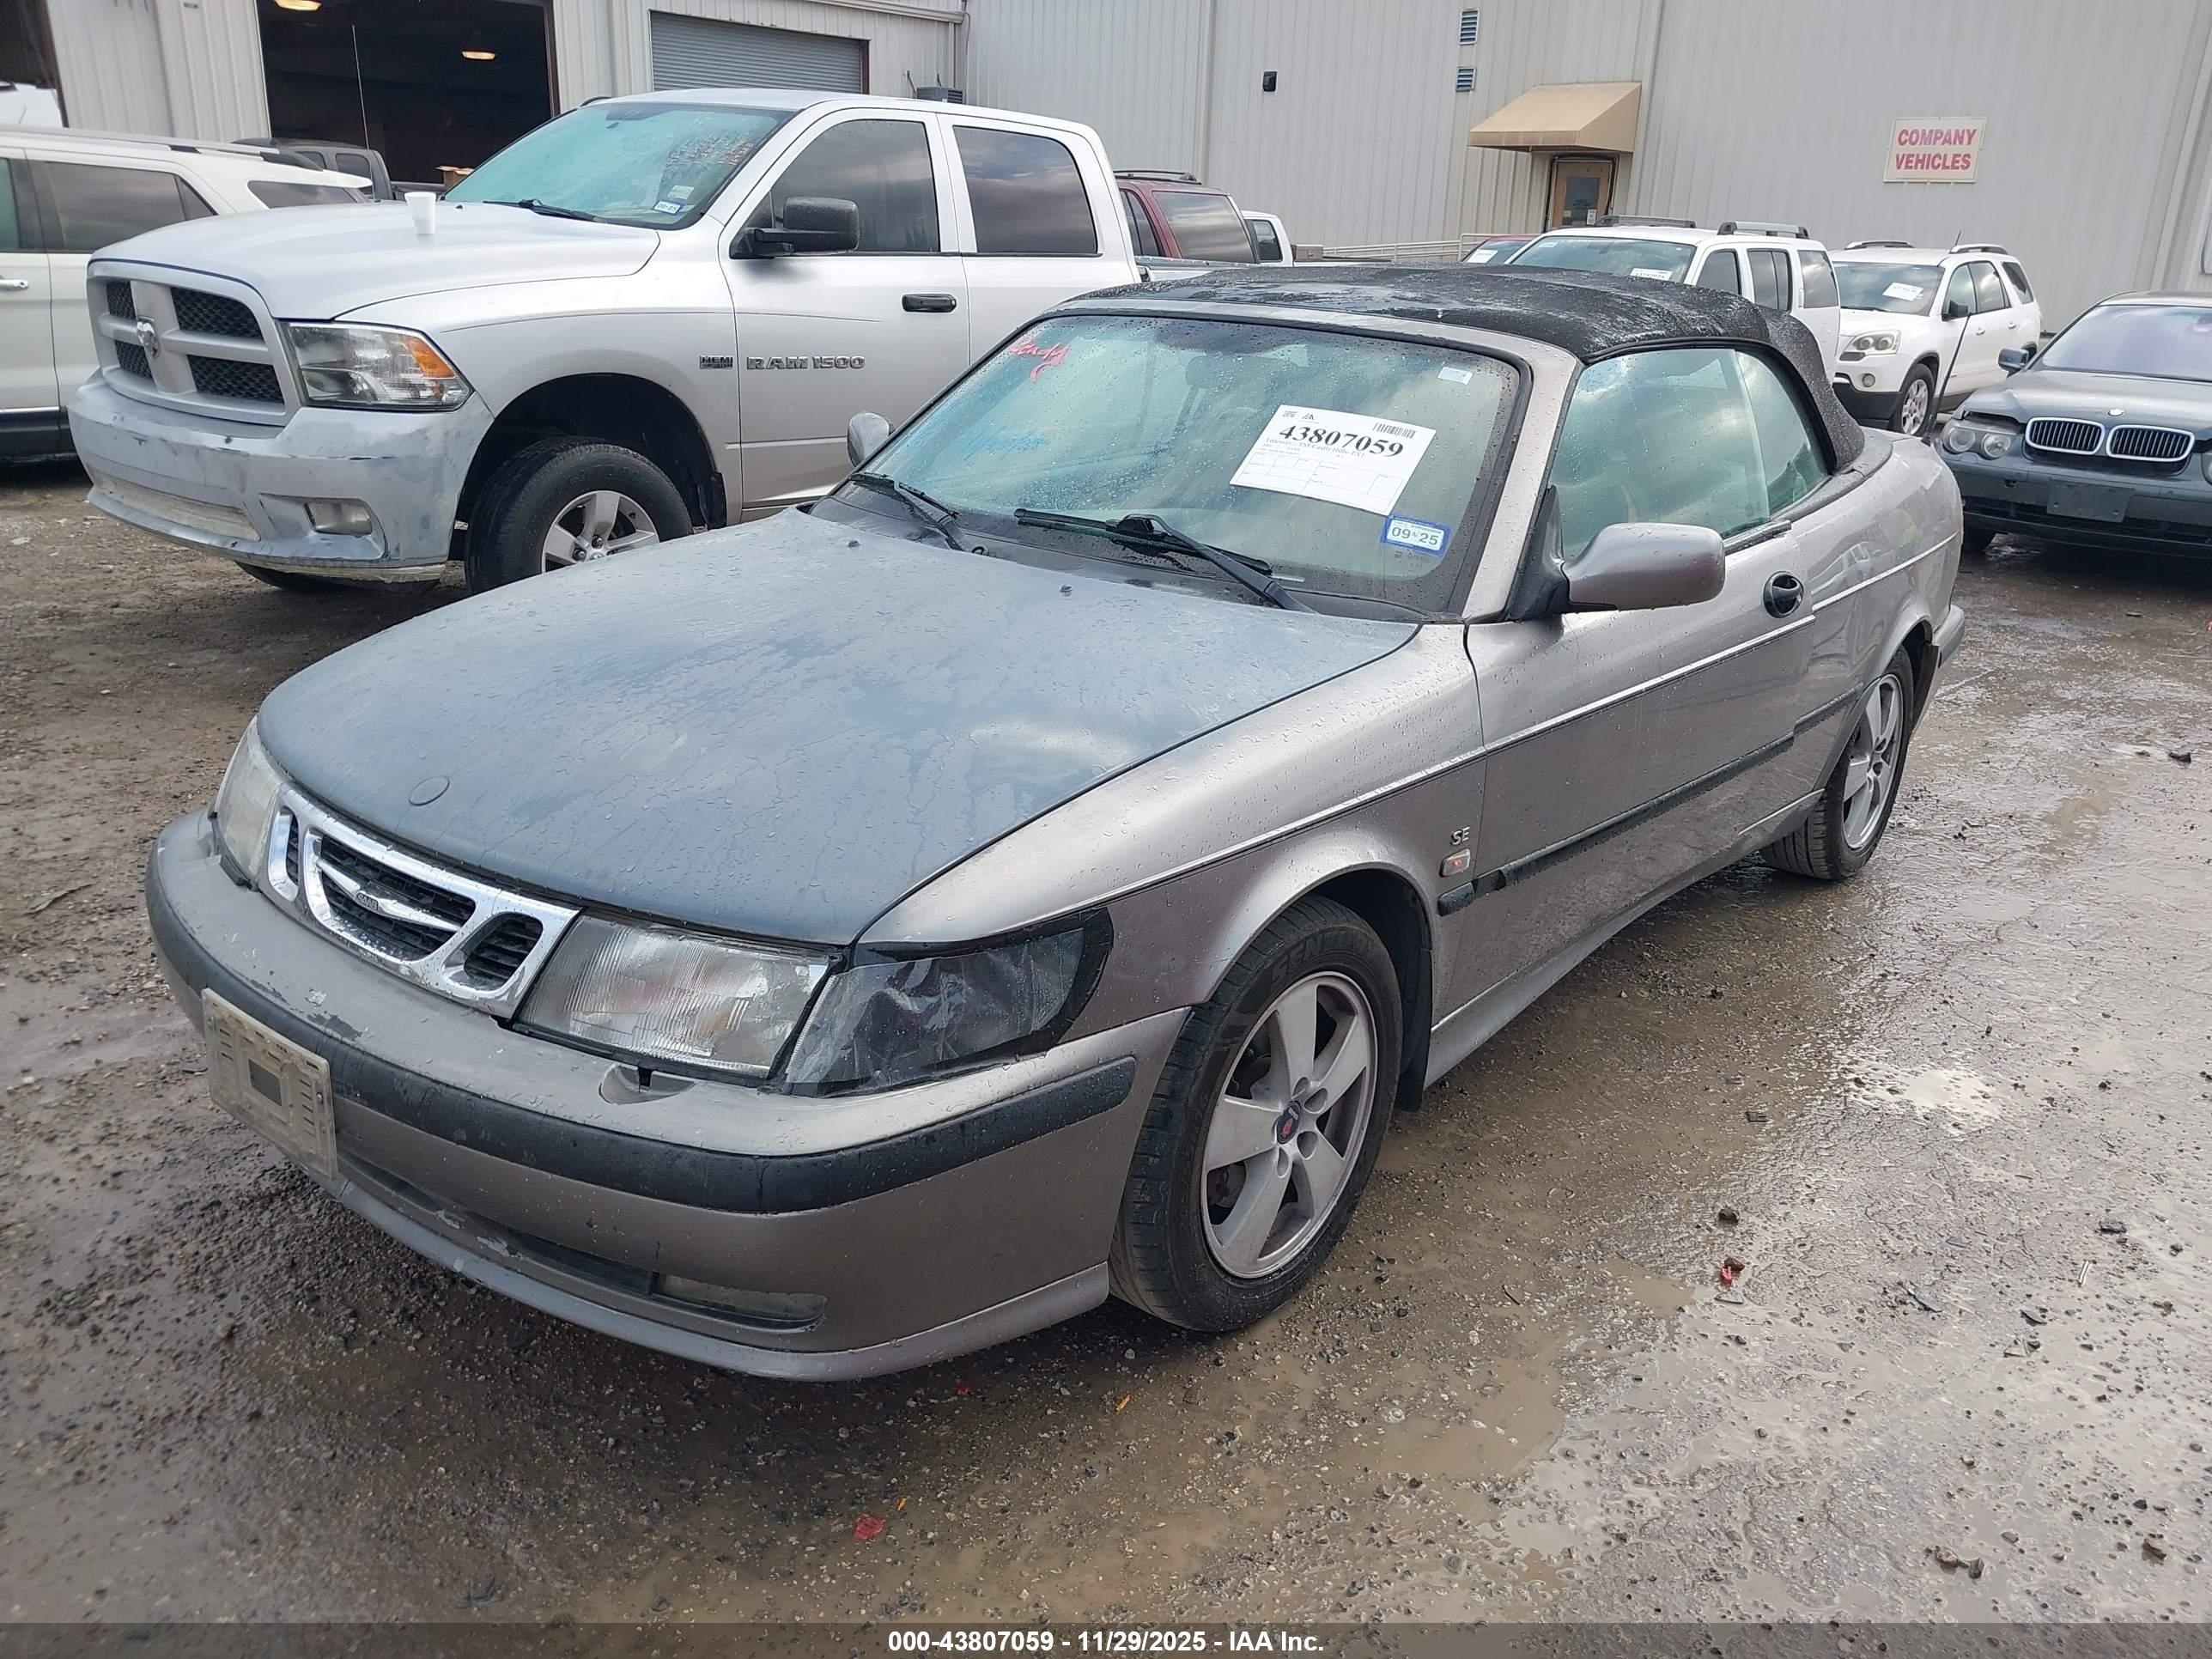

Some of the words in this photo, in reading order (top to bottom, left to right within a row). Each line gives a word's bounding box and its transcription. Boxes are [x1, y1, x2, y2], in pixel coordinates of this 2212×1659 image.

[1898, 129, 1977, 146] COMPANY
[1895, 153, 1972, 170] VEHICLES
[701, 356, 733, 364] HEMI
[746, 356, 808, 370] RAM
[811, 356, 866, 369] 1500
[1279, 425, 1404, 458] 43807059
[1391, 526, 1411, 539] 09
[1419, 532, 1439, 545] 25
[1449, 826, 1470, 846] SE
[356, 893, 378, 910] SAAB
